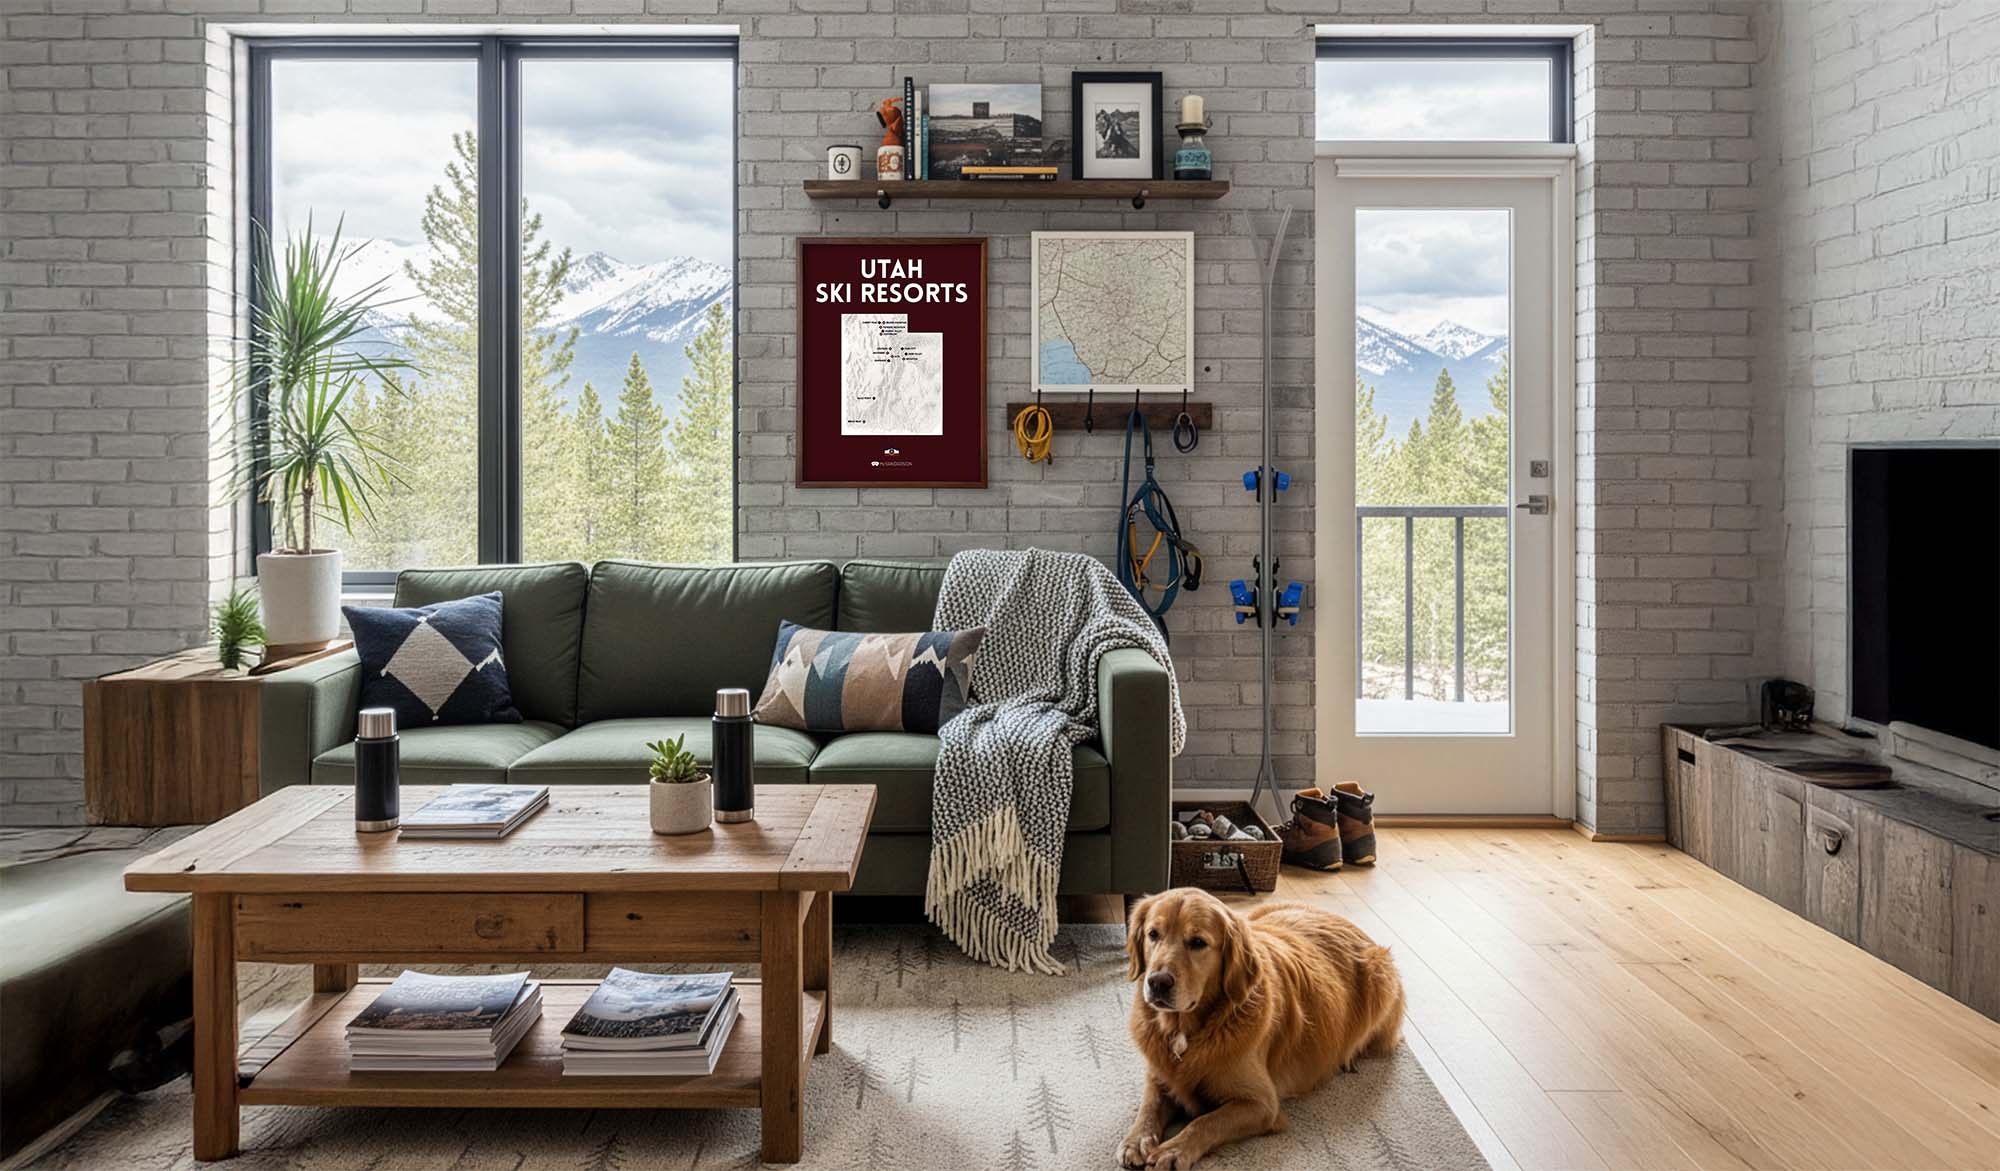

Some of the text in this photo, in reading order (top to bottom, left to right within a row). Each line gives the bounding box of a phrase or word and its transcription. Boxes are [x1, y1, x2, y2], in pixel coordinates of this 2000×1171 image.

[861, 258, 923, 279] UTAH
[816, 282, 968, 303] SKI RESORTS
